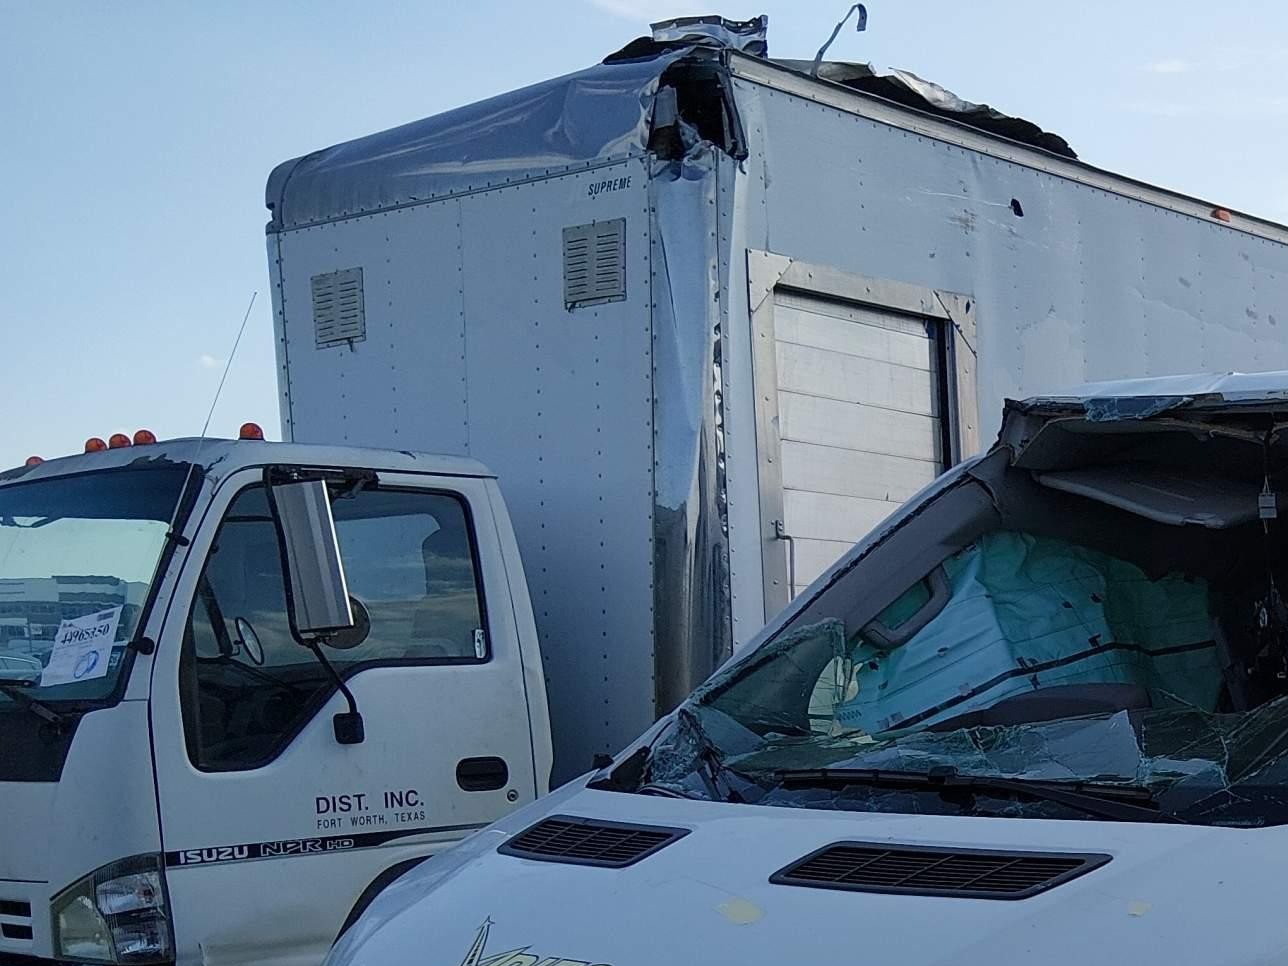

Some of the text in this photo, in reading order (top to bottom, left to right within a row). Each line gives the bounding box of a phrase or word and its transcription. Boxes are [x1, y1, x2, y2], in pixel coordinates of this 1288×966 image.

[588, 175, 632, 196] SUPREME
[315, 789, 424, 815] DIST. INC.
[316, 819, 342, 829] FORT
[394, 810, 426, 823] TEXAS
[179, 846, 248, 865] ISUZU
[260, 838, 322, 857] NPR
